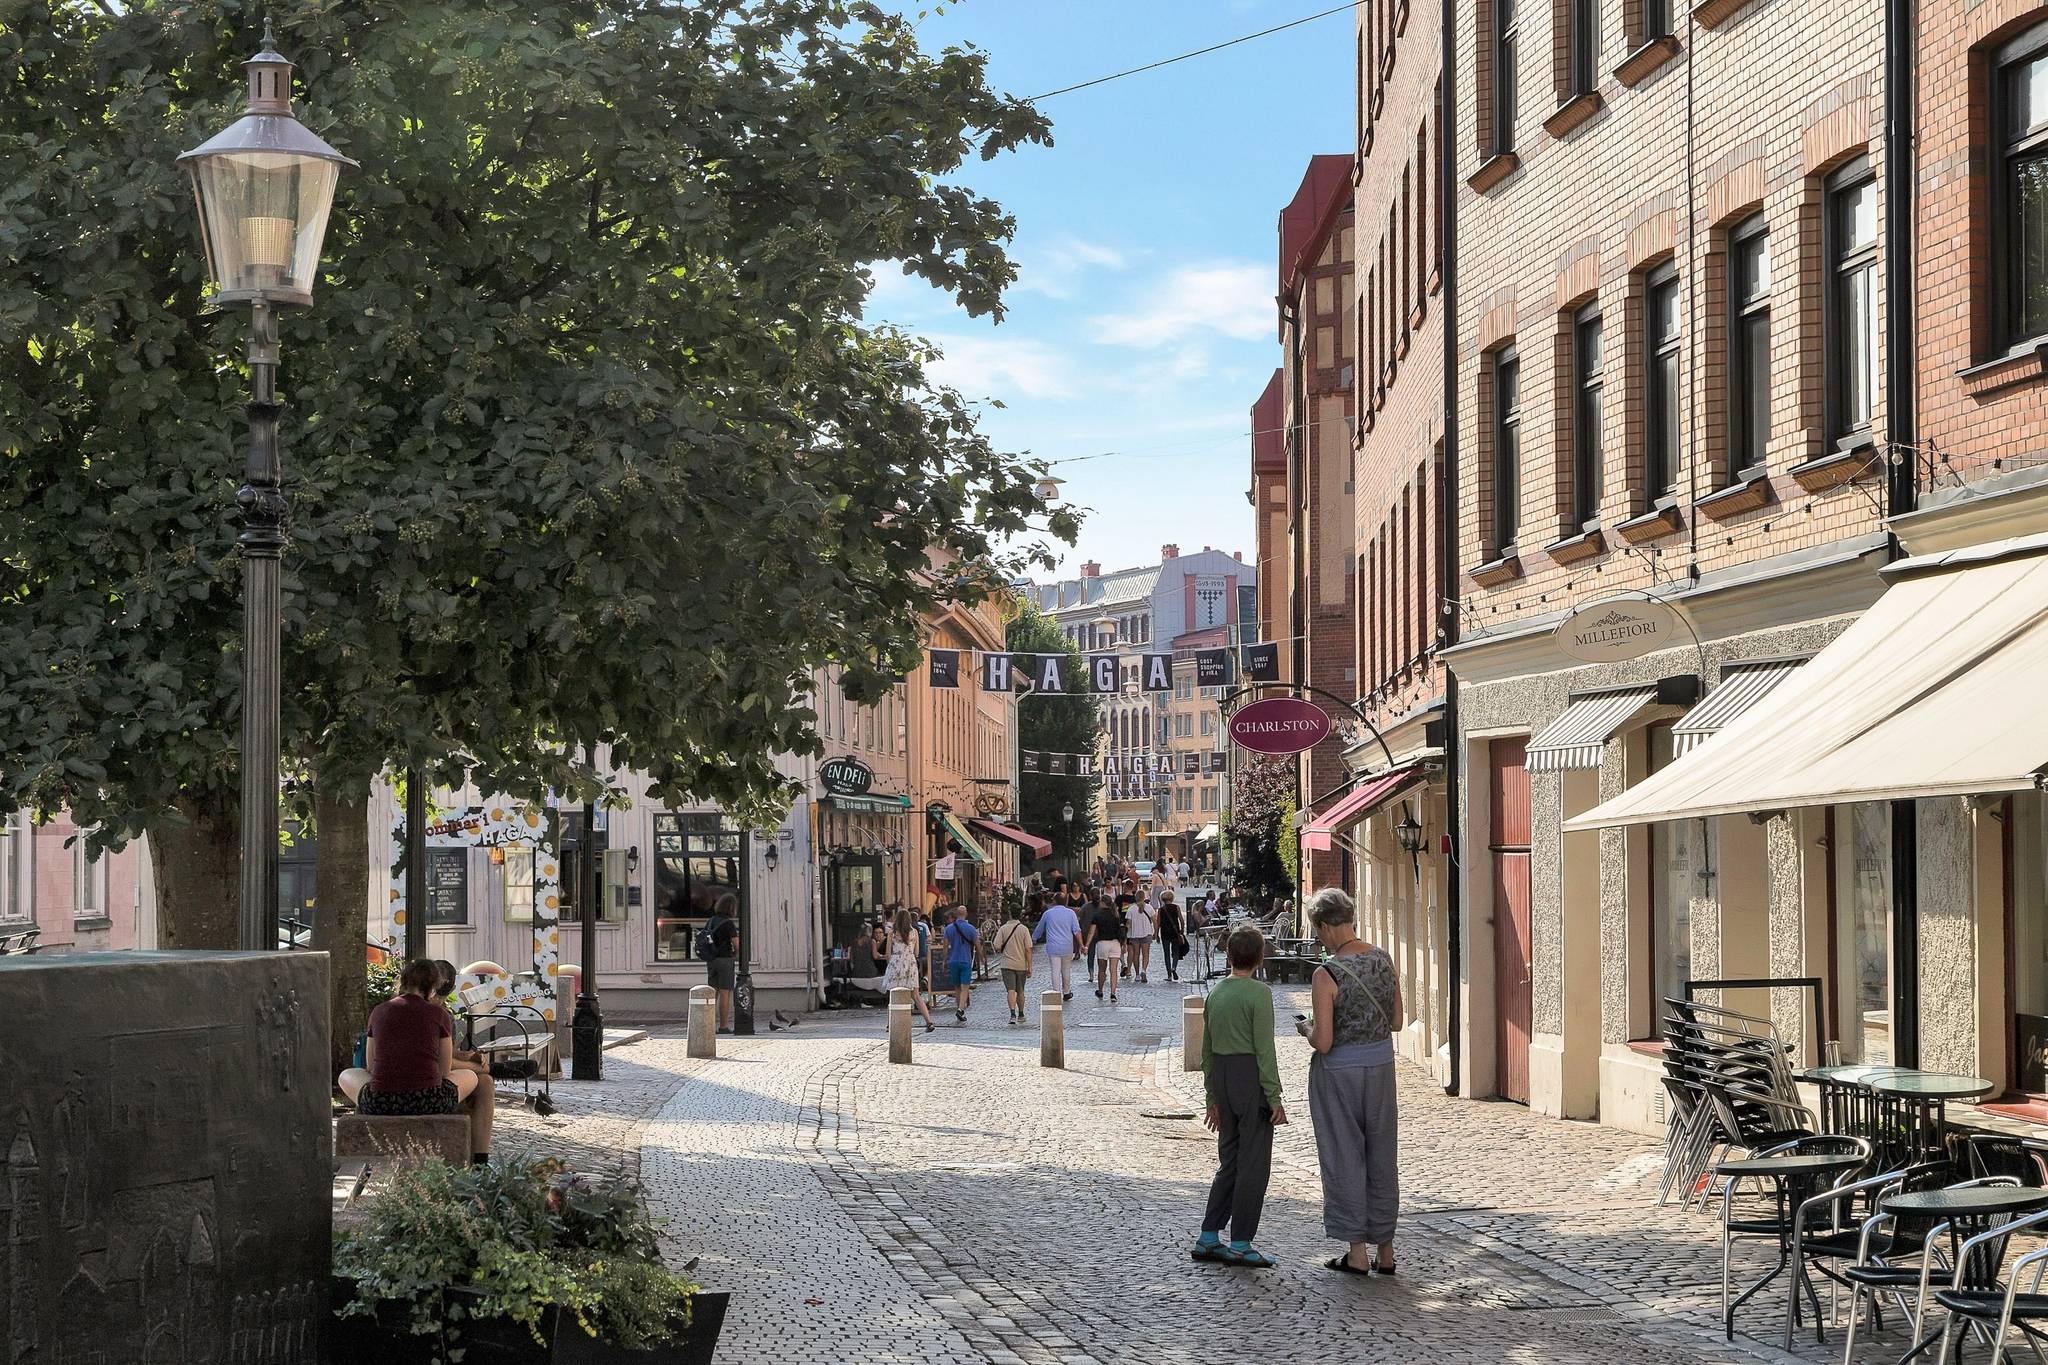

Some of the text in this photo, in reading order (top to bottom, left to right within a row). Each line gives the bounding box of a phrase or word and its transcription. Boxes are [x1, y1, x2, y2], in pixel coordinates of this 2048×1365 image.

[1575, 622, 1657, 646] MILLEFIORI
[990, 656, 1168, 691] HAGA
[1236, 720, 1319, 733] CHARLSTON
[828, 764, 842, 780] EN
[1080, 757, 1171, 774] HAGA
[425, 820, 480, 837] ommar
[482, 827, 533, 845] HAGA
